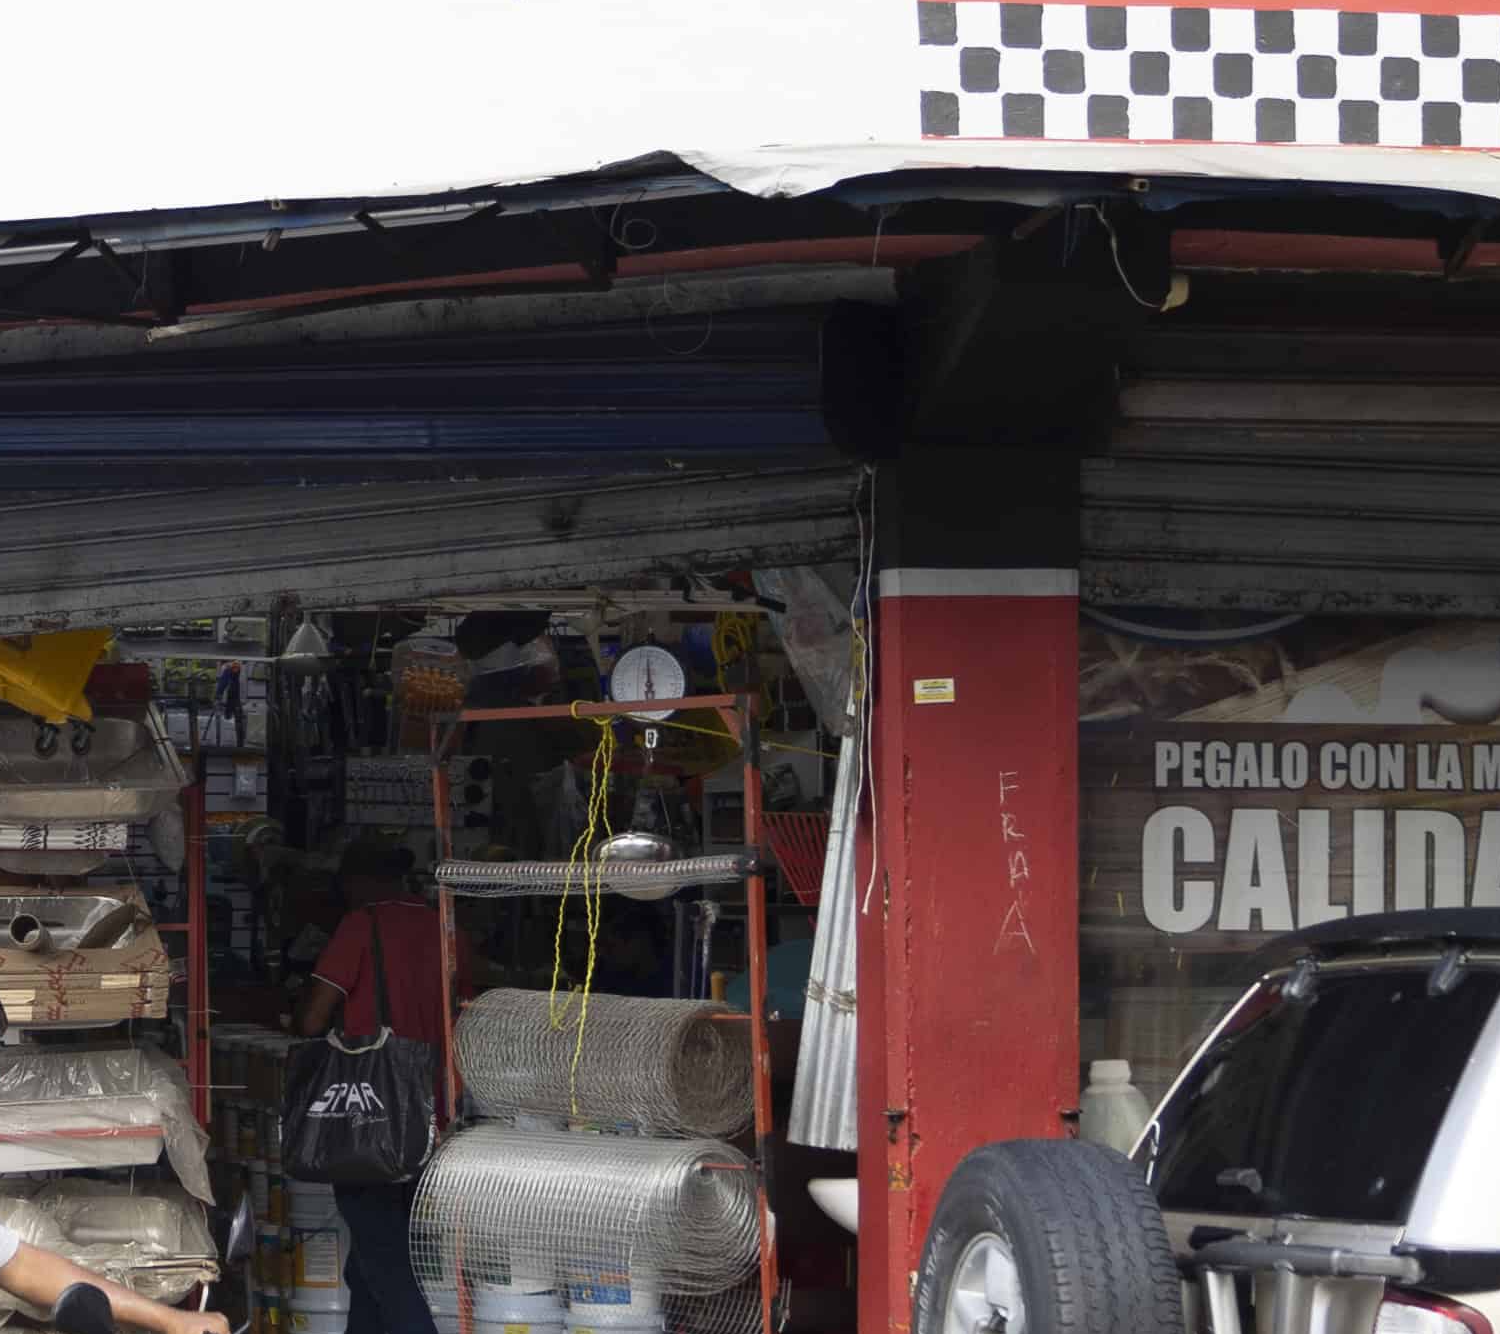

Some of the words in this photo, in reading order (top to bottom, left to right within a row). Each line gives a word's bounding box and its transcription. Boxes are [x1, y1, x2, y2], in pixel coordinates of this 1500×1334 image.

[1154, 740, 1309, 790] PEGALO
[1318, 741, 1404, 791] CON
[1416, 742, 1462, 792] LA
[308, 1082, 385, 1112] SPAR
